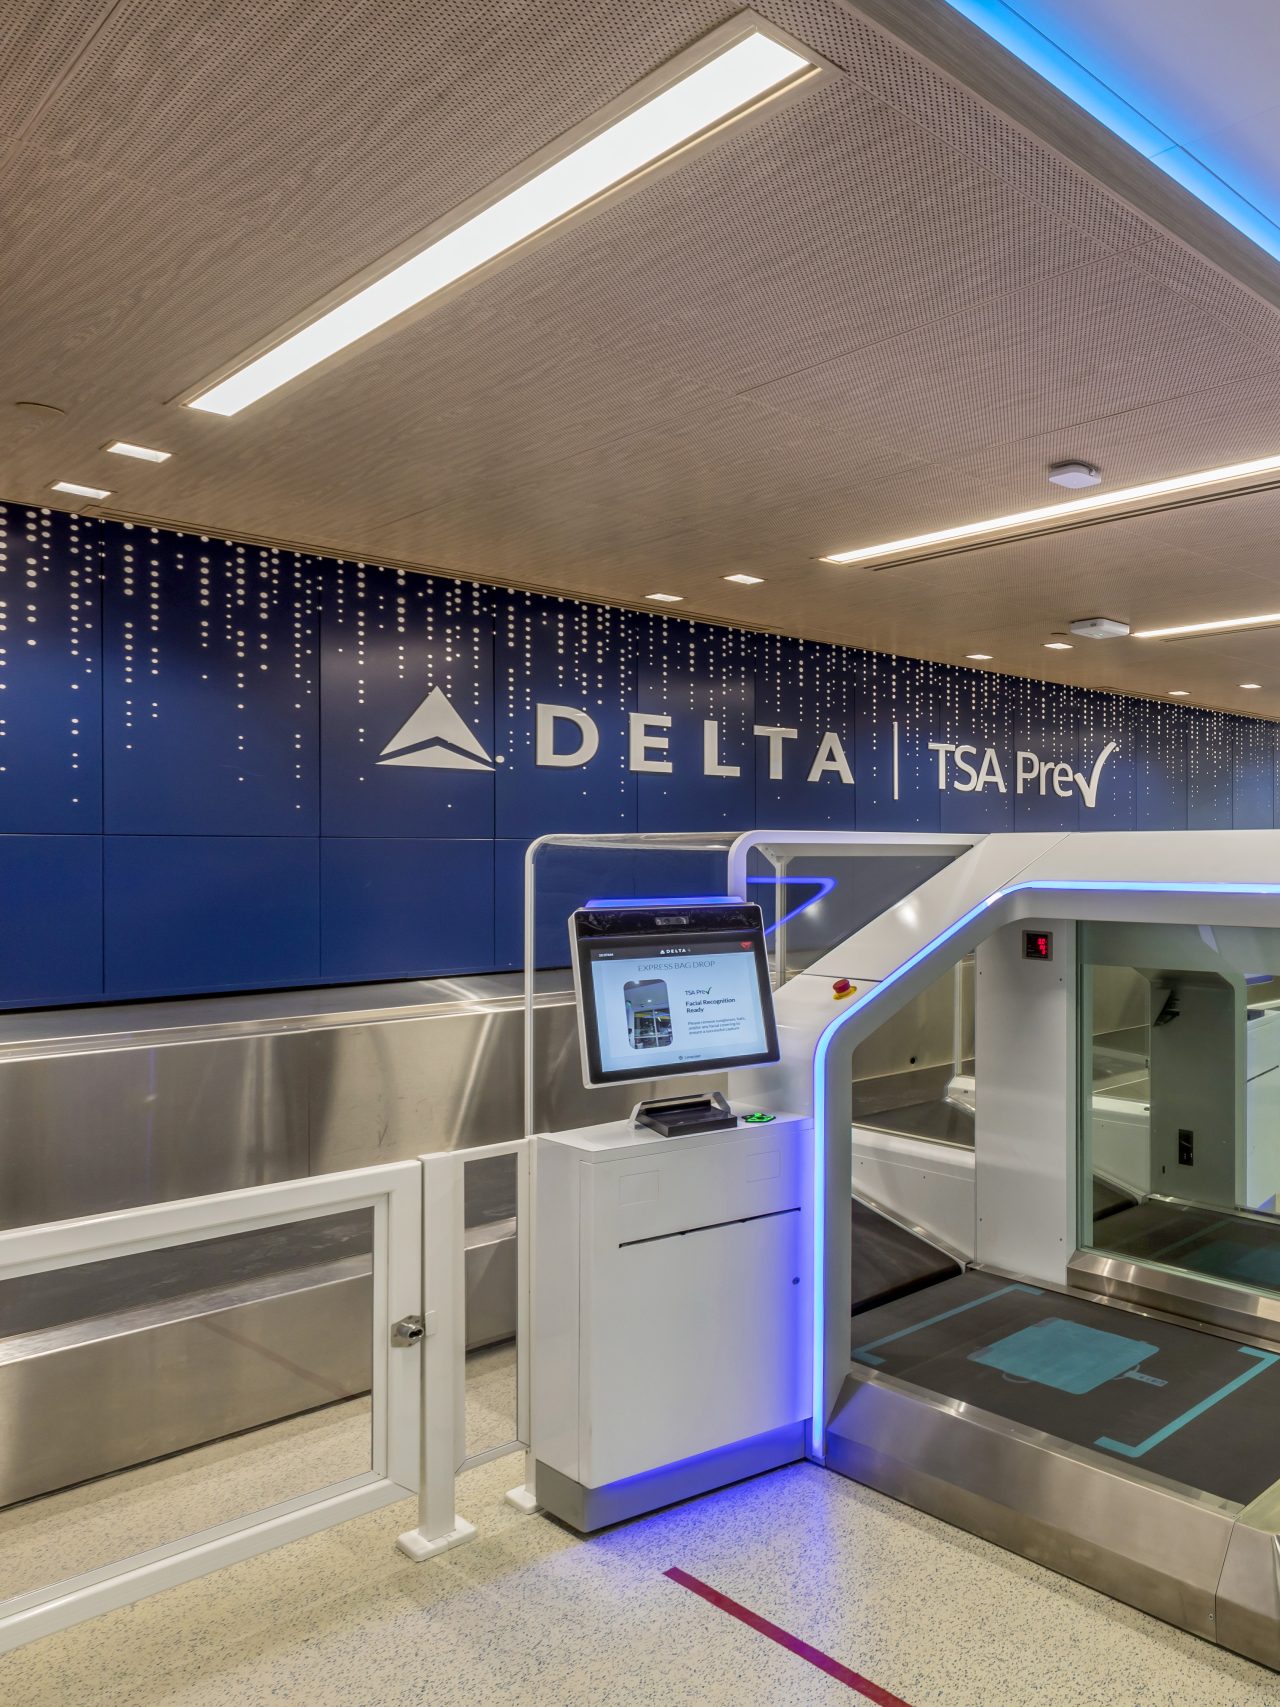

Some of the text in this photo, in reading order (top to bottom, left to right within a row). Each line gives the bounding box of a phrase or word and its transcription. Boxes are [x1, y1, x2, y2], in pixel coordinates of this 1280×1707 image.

[536, 703, 855, 784] DELTA
[928, 742, 1007, 793] TSA
[638, 960, 716, 972] EXPRESS BAG DROP
[703, 997, 736, 1006] Recognition
